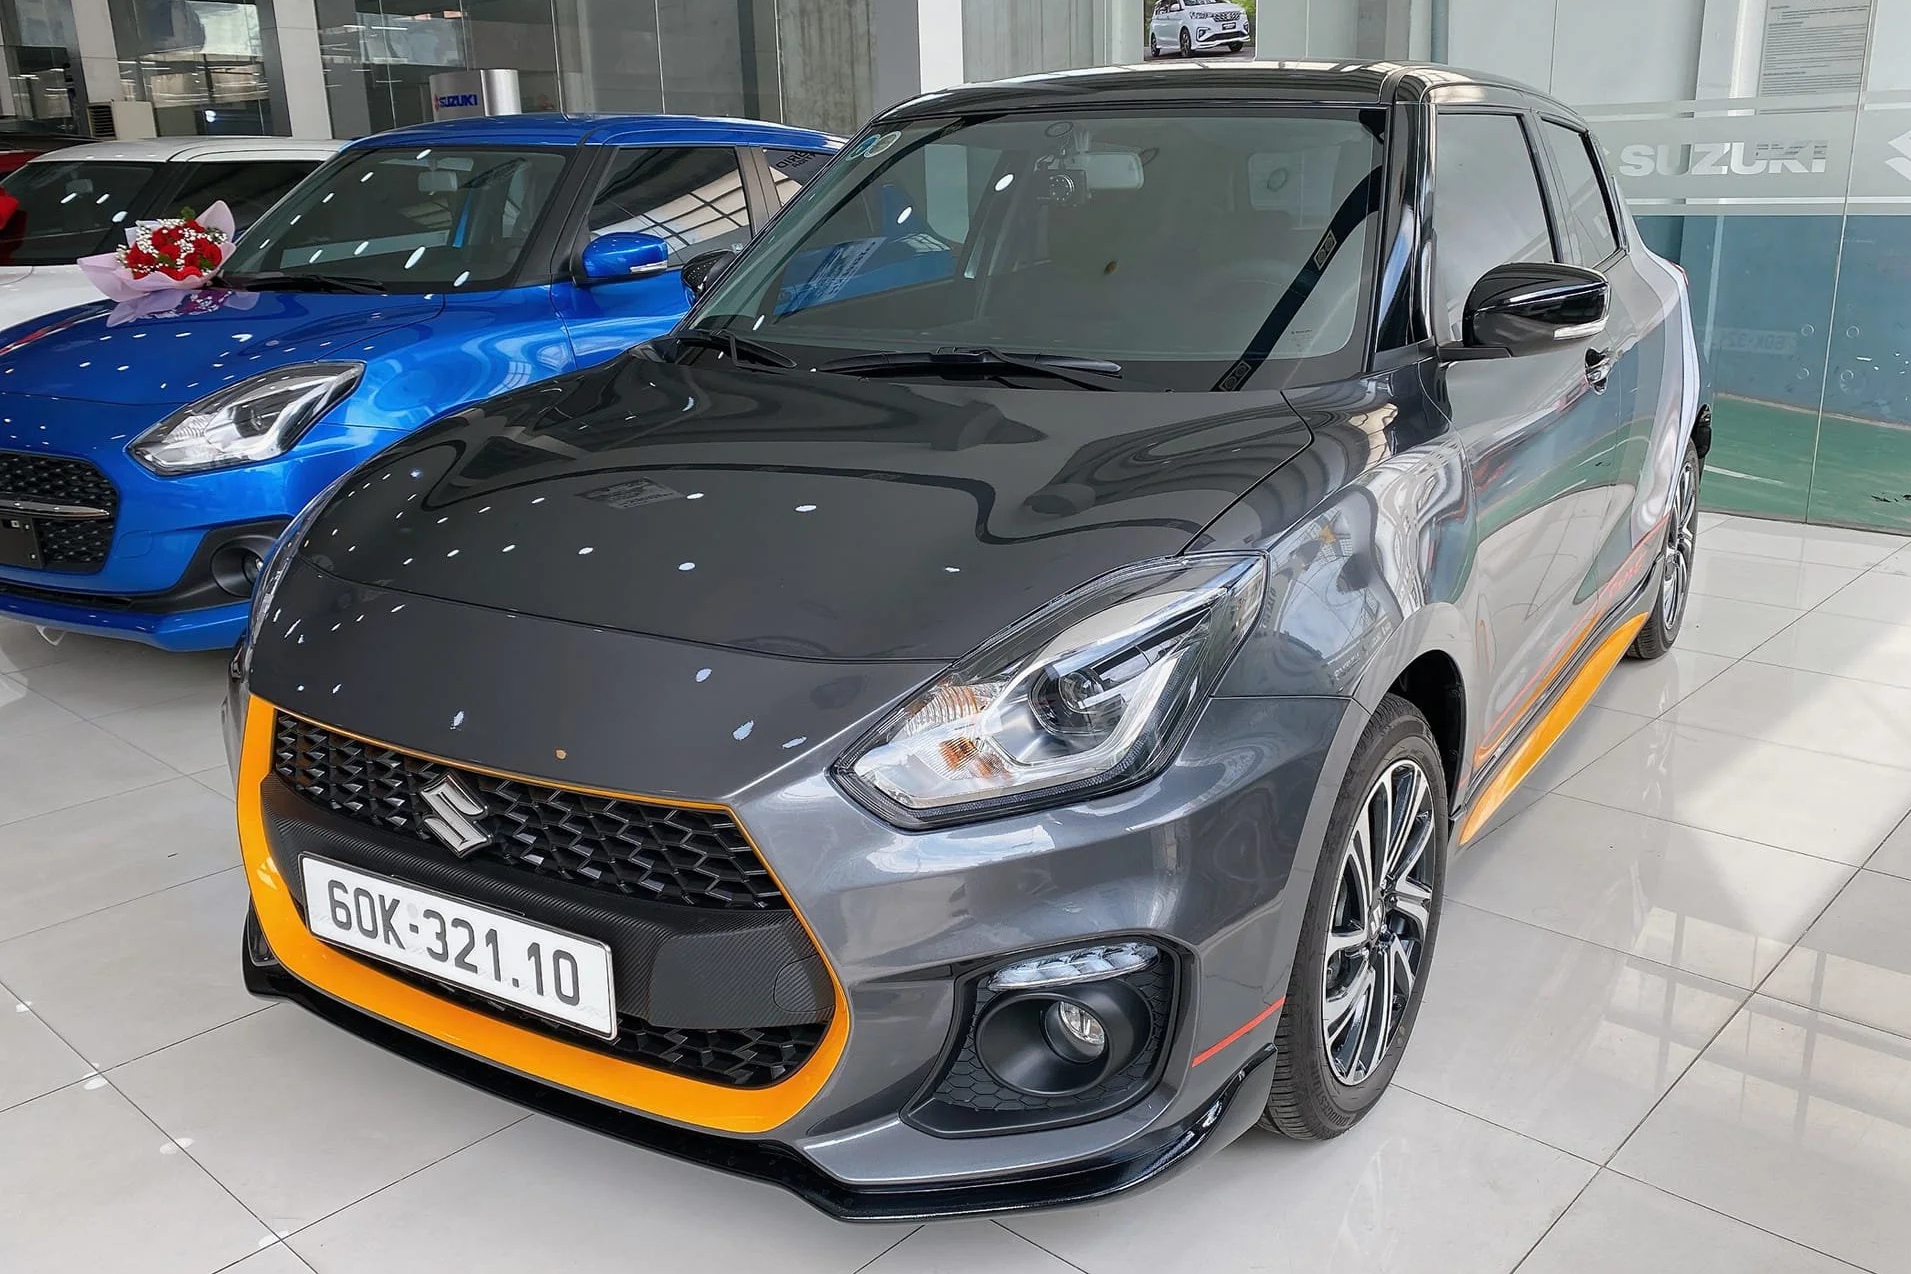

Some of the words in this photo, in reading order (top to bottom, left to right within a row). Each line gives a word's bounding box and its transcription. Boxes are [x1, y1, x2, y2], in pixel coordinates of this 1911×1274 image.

[439, 94, 478, 108] SUZUKI
[1619, 140, 1829, 177] SUZUKI
[327, 879, 580, 1006] 60K-321.10
